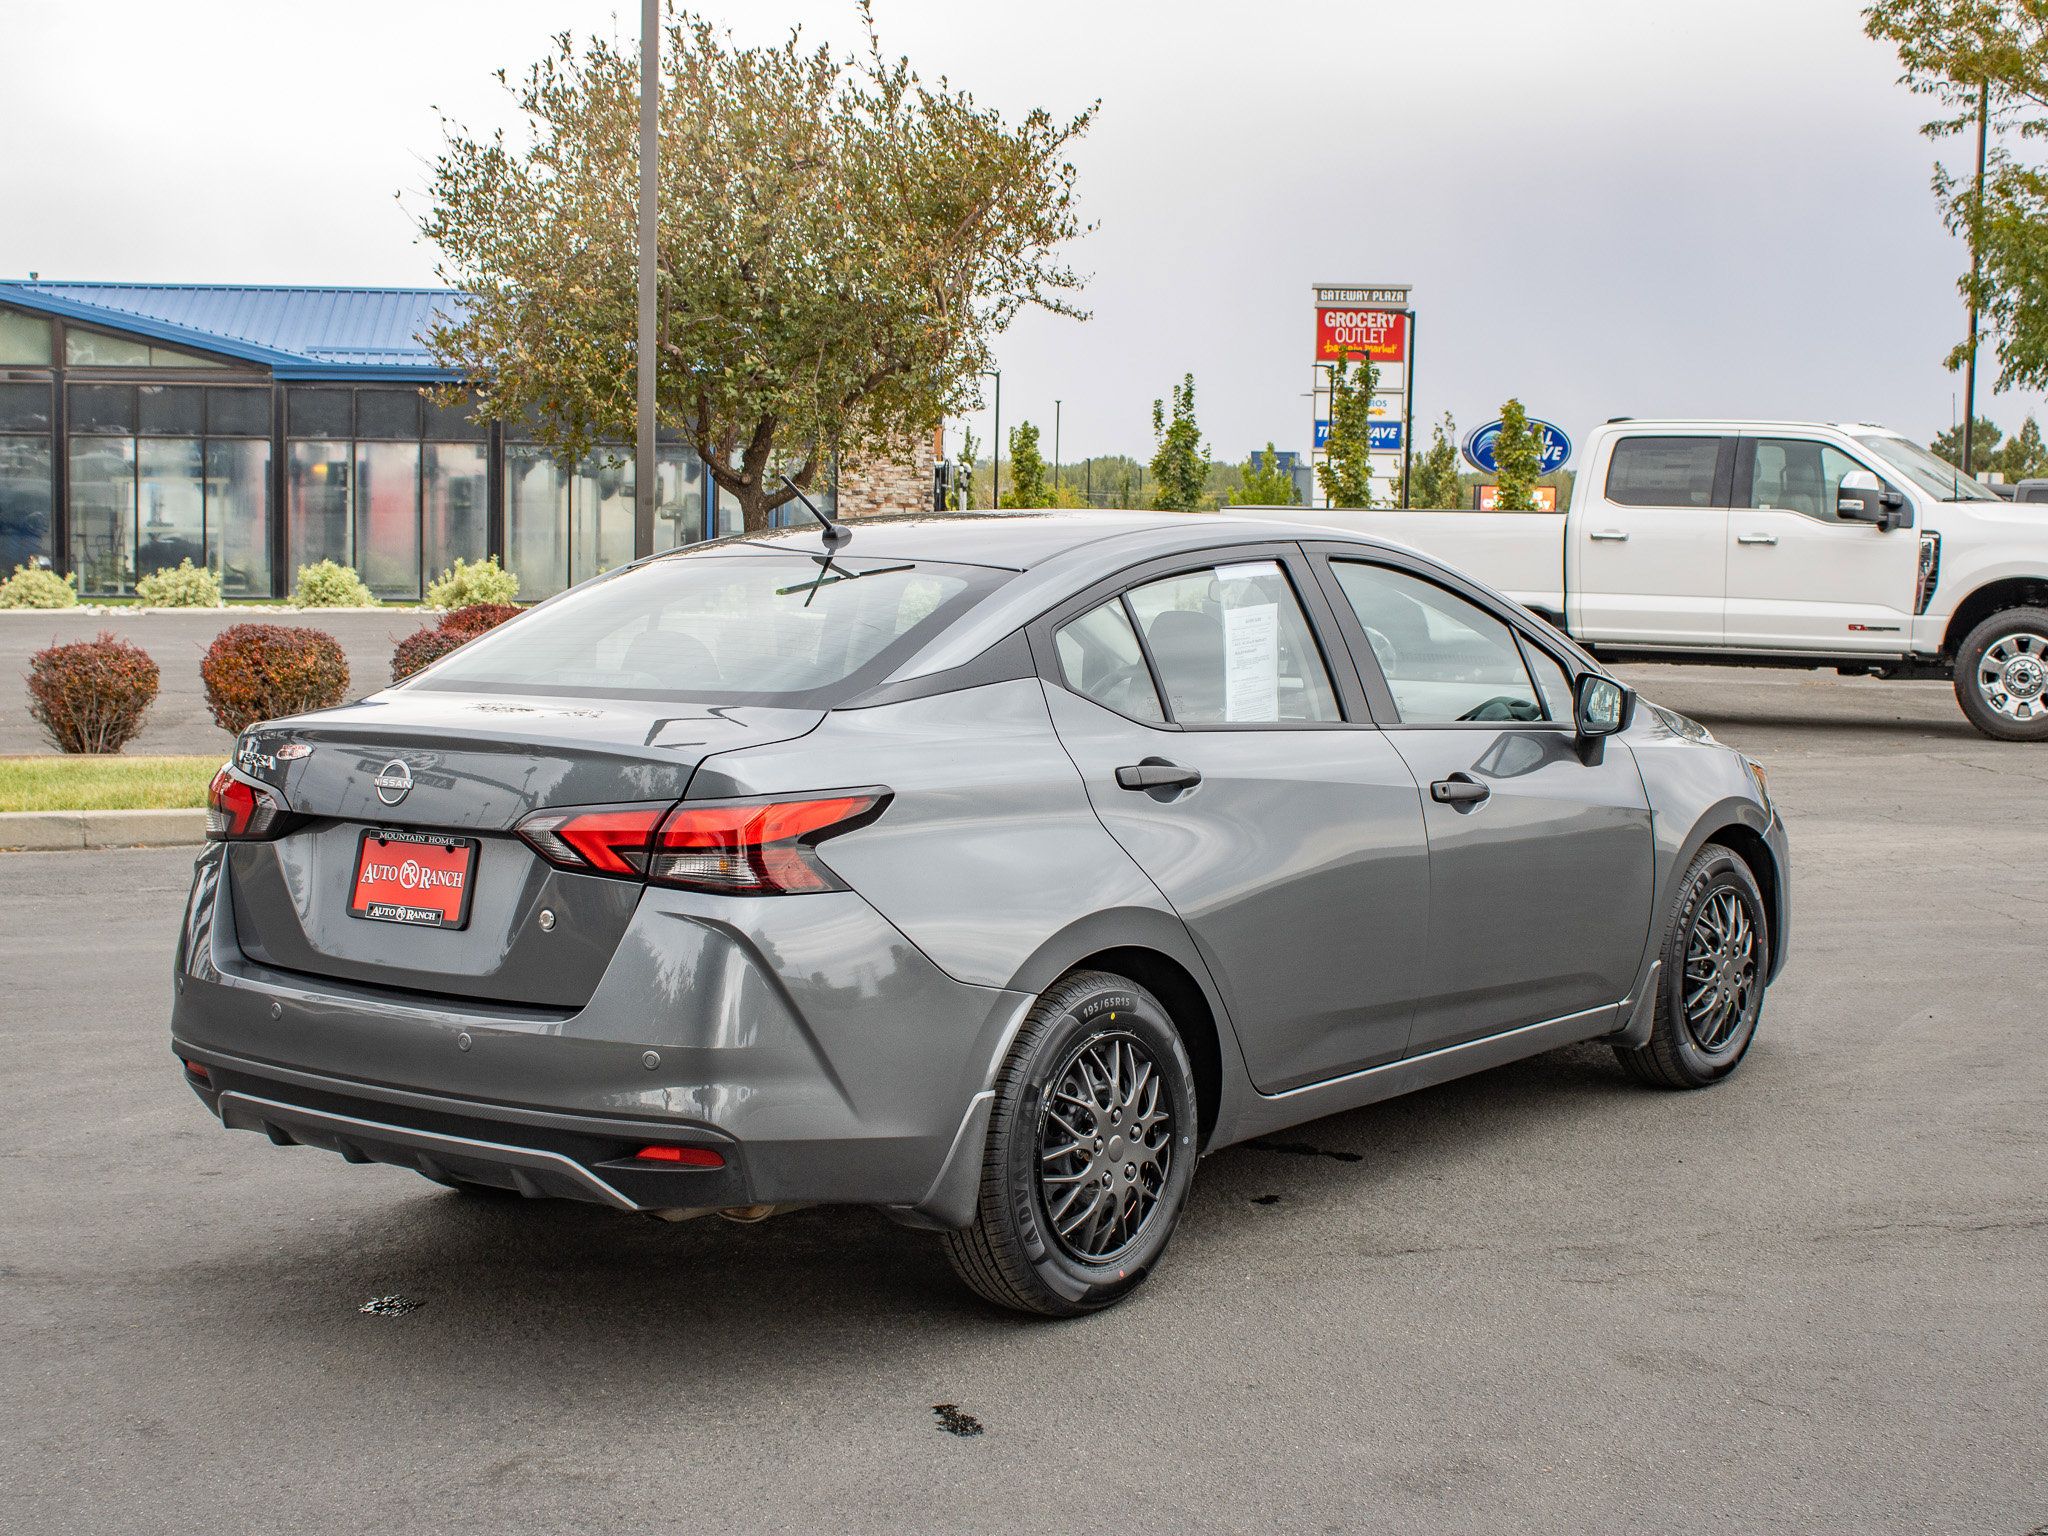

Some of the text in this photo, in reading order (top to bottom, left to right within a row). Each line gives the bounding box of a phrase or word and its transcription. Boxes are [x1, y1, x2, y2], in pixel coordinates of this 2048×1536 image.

[1321, 290, 1404, 302] GATEWAY PLAZA
[1324, 311, 1396, 328] GROCERY
[1335, 327, 1387, 343] OUTLET
[1367, 427, 1397, 439] AVE
[374, 778, 413, 789] NISSAN
[380, 832, 455, 845] MOUNTAIN HOME
[361, 862, 398, 884] AUTO
[419, 867, 463, 889] RANCH
[371, 906, 396, 917] AUTO
[406, 909, 436, 921] RANCH
[1083, 997, 1130, 1018] 195/65R15
